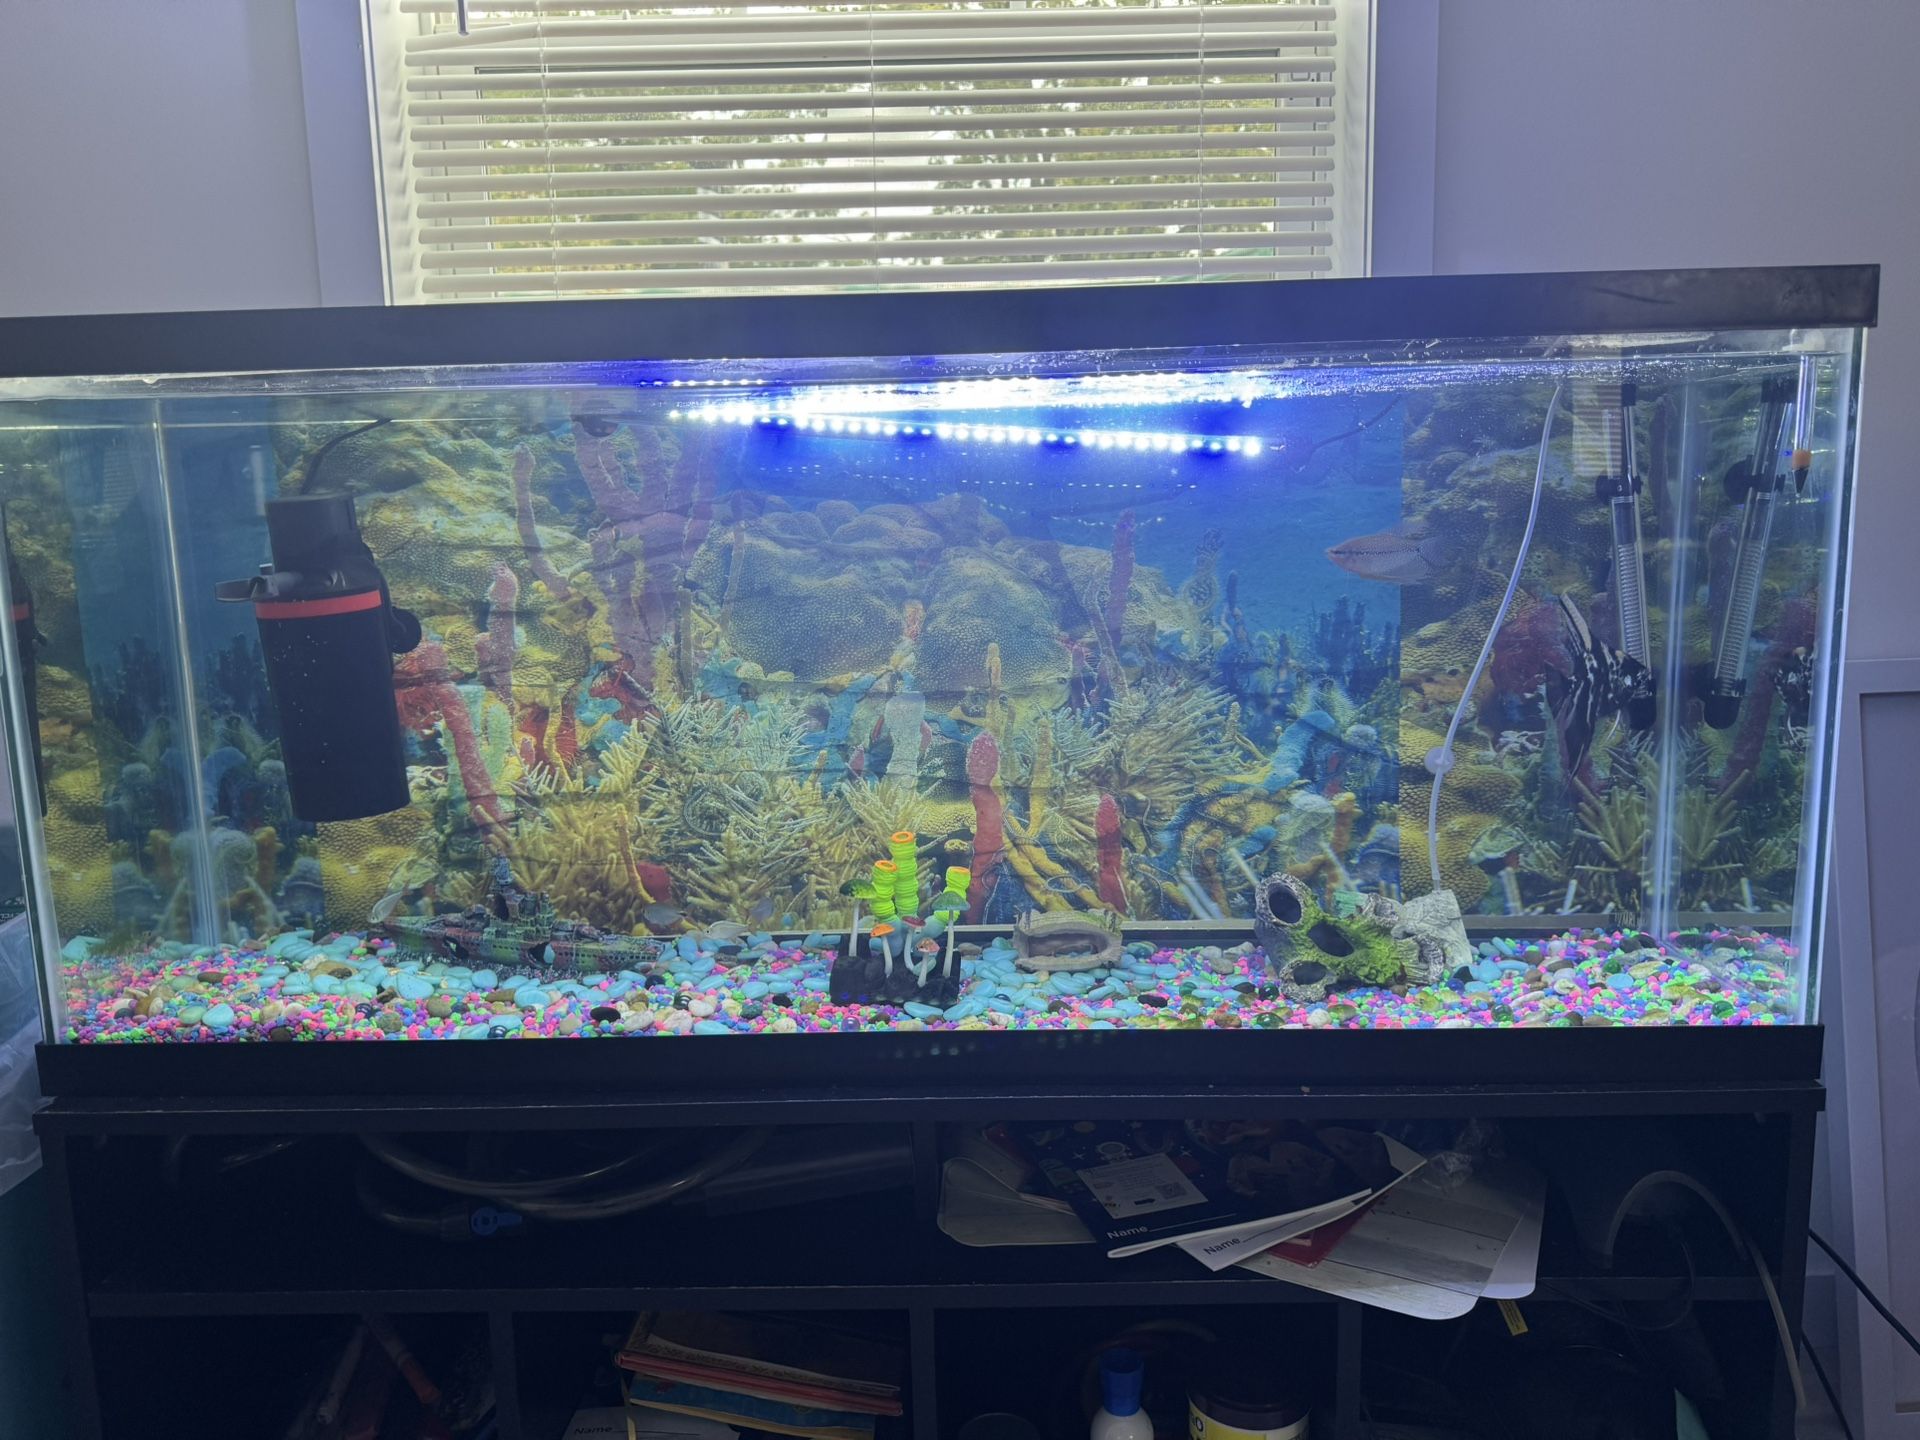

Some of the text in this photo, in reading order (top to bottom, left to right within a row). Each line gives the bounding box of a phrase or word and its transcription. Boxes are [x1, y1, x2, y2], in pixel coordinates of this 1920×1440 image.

[1106, 1225, 1149, 1240] Name
[1203, 1238, 1241, 1255] Name
[574, 1425, 613, 1435] Name
